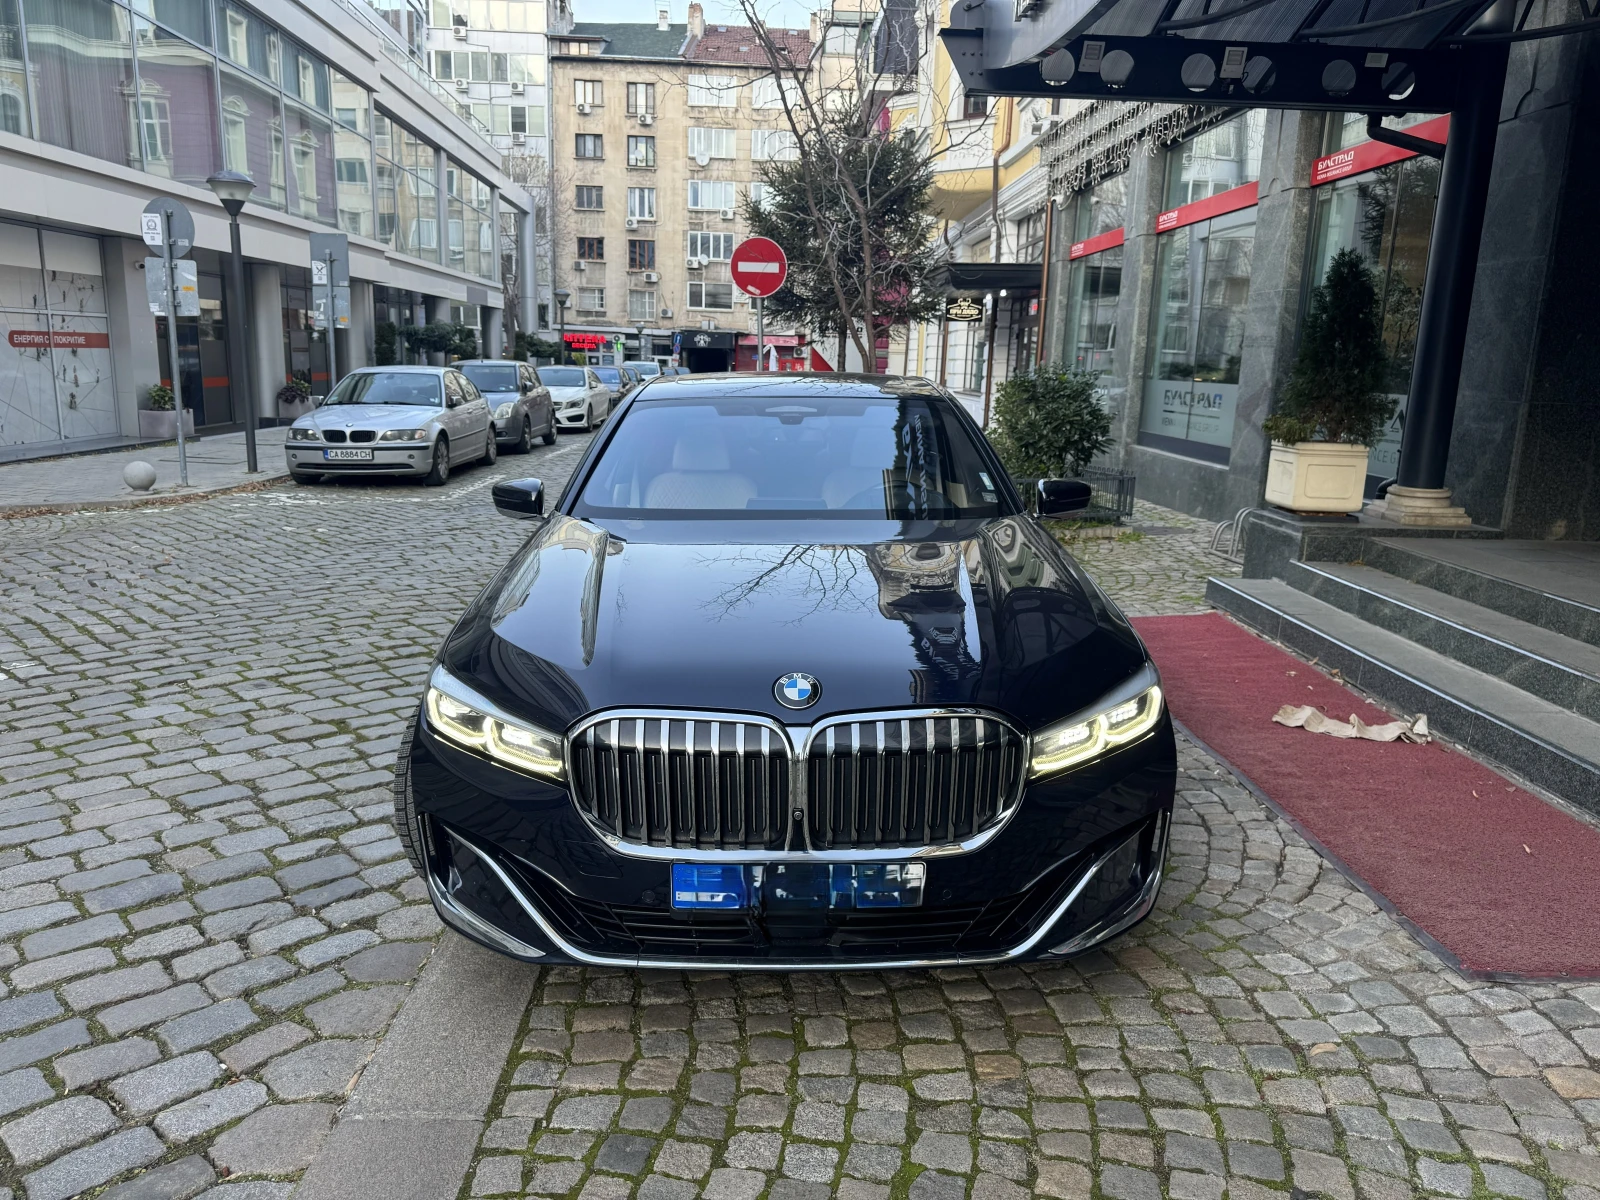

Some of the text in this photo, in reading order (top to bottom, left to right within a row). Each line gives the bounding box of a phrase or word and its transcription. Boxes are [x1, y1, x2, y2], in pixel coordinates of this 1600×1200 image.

[1318, 150, 1354, 171] БУЛСТРАД
[13, 334, 43, 344] ЕНЕРГИЯ
[53, 335, 87, 345] ПОКРИТИЕ
[563, 333, 607, 344] АПТЕКА
[329, 450, 371, 459] CA 8884 CH
[779, 673, 815, 685] BMW
